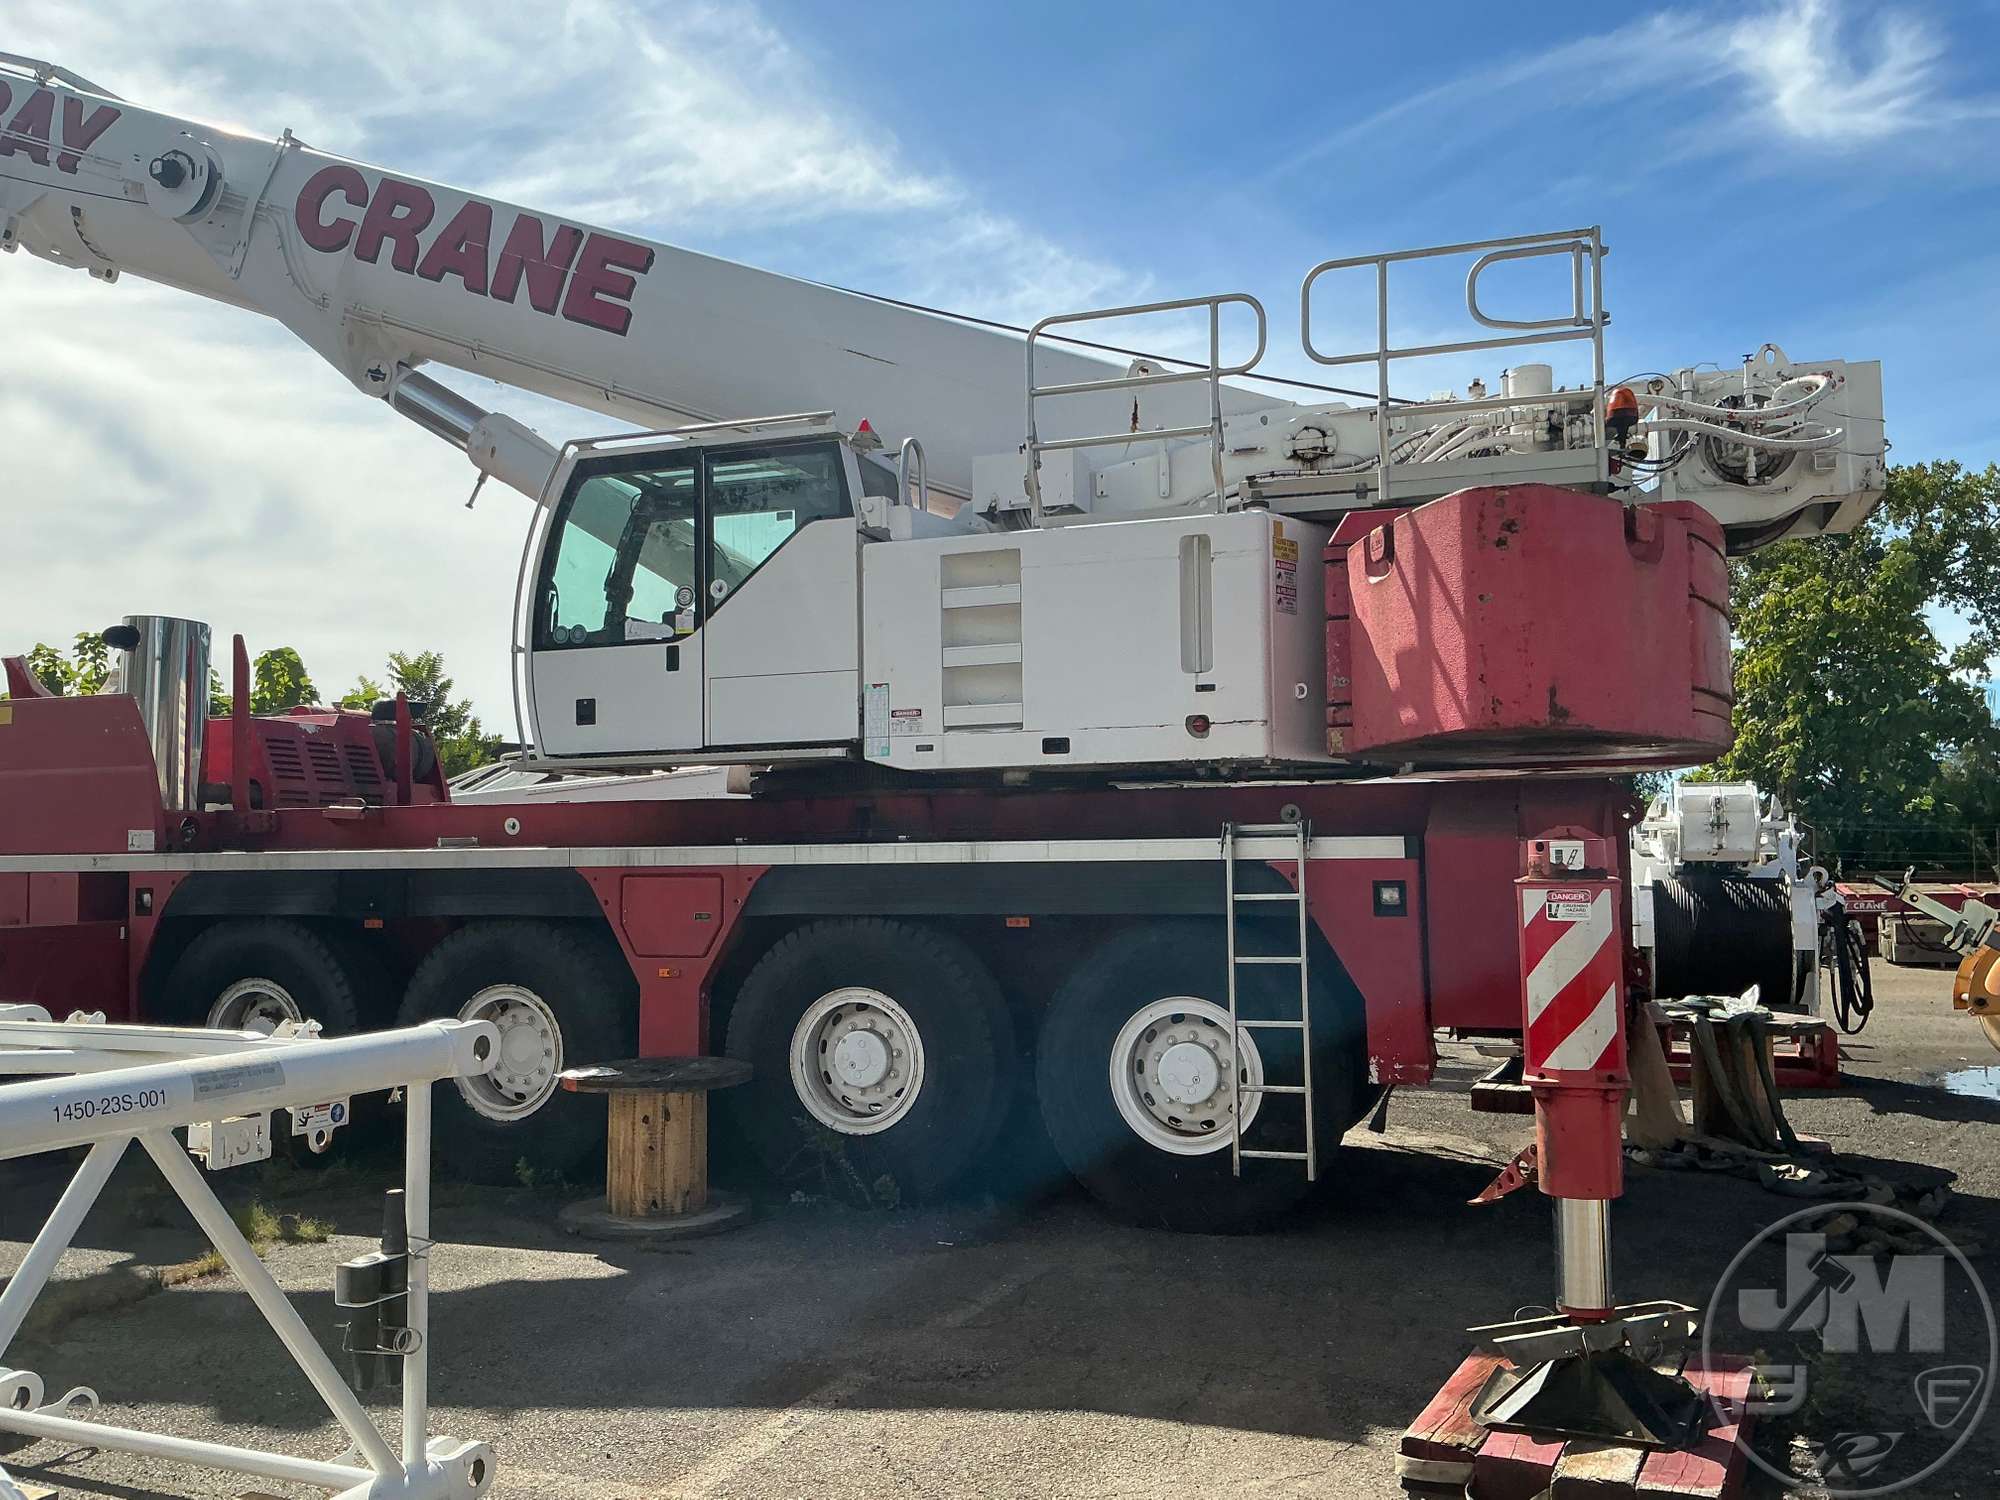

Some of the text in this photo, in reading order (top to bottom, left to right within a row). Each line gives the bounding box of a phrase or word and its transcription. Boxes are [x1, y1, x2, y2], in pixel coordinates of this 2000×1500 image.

[295, 165, 655, 337] CRANE
[1551, 893, 1585, 901] DANGER
[1853, 902, 1887, 910] CRANE
[53, 1089, 166, 1122] 1450-23S-001
